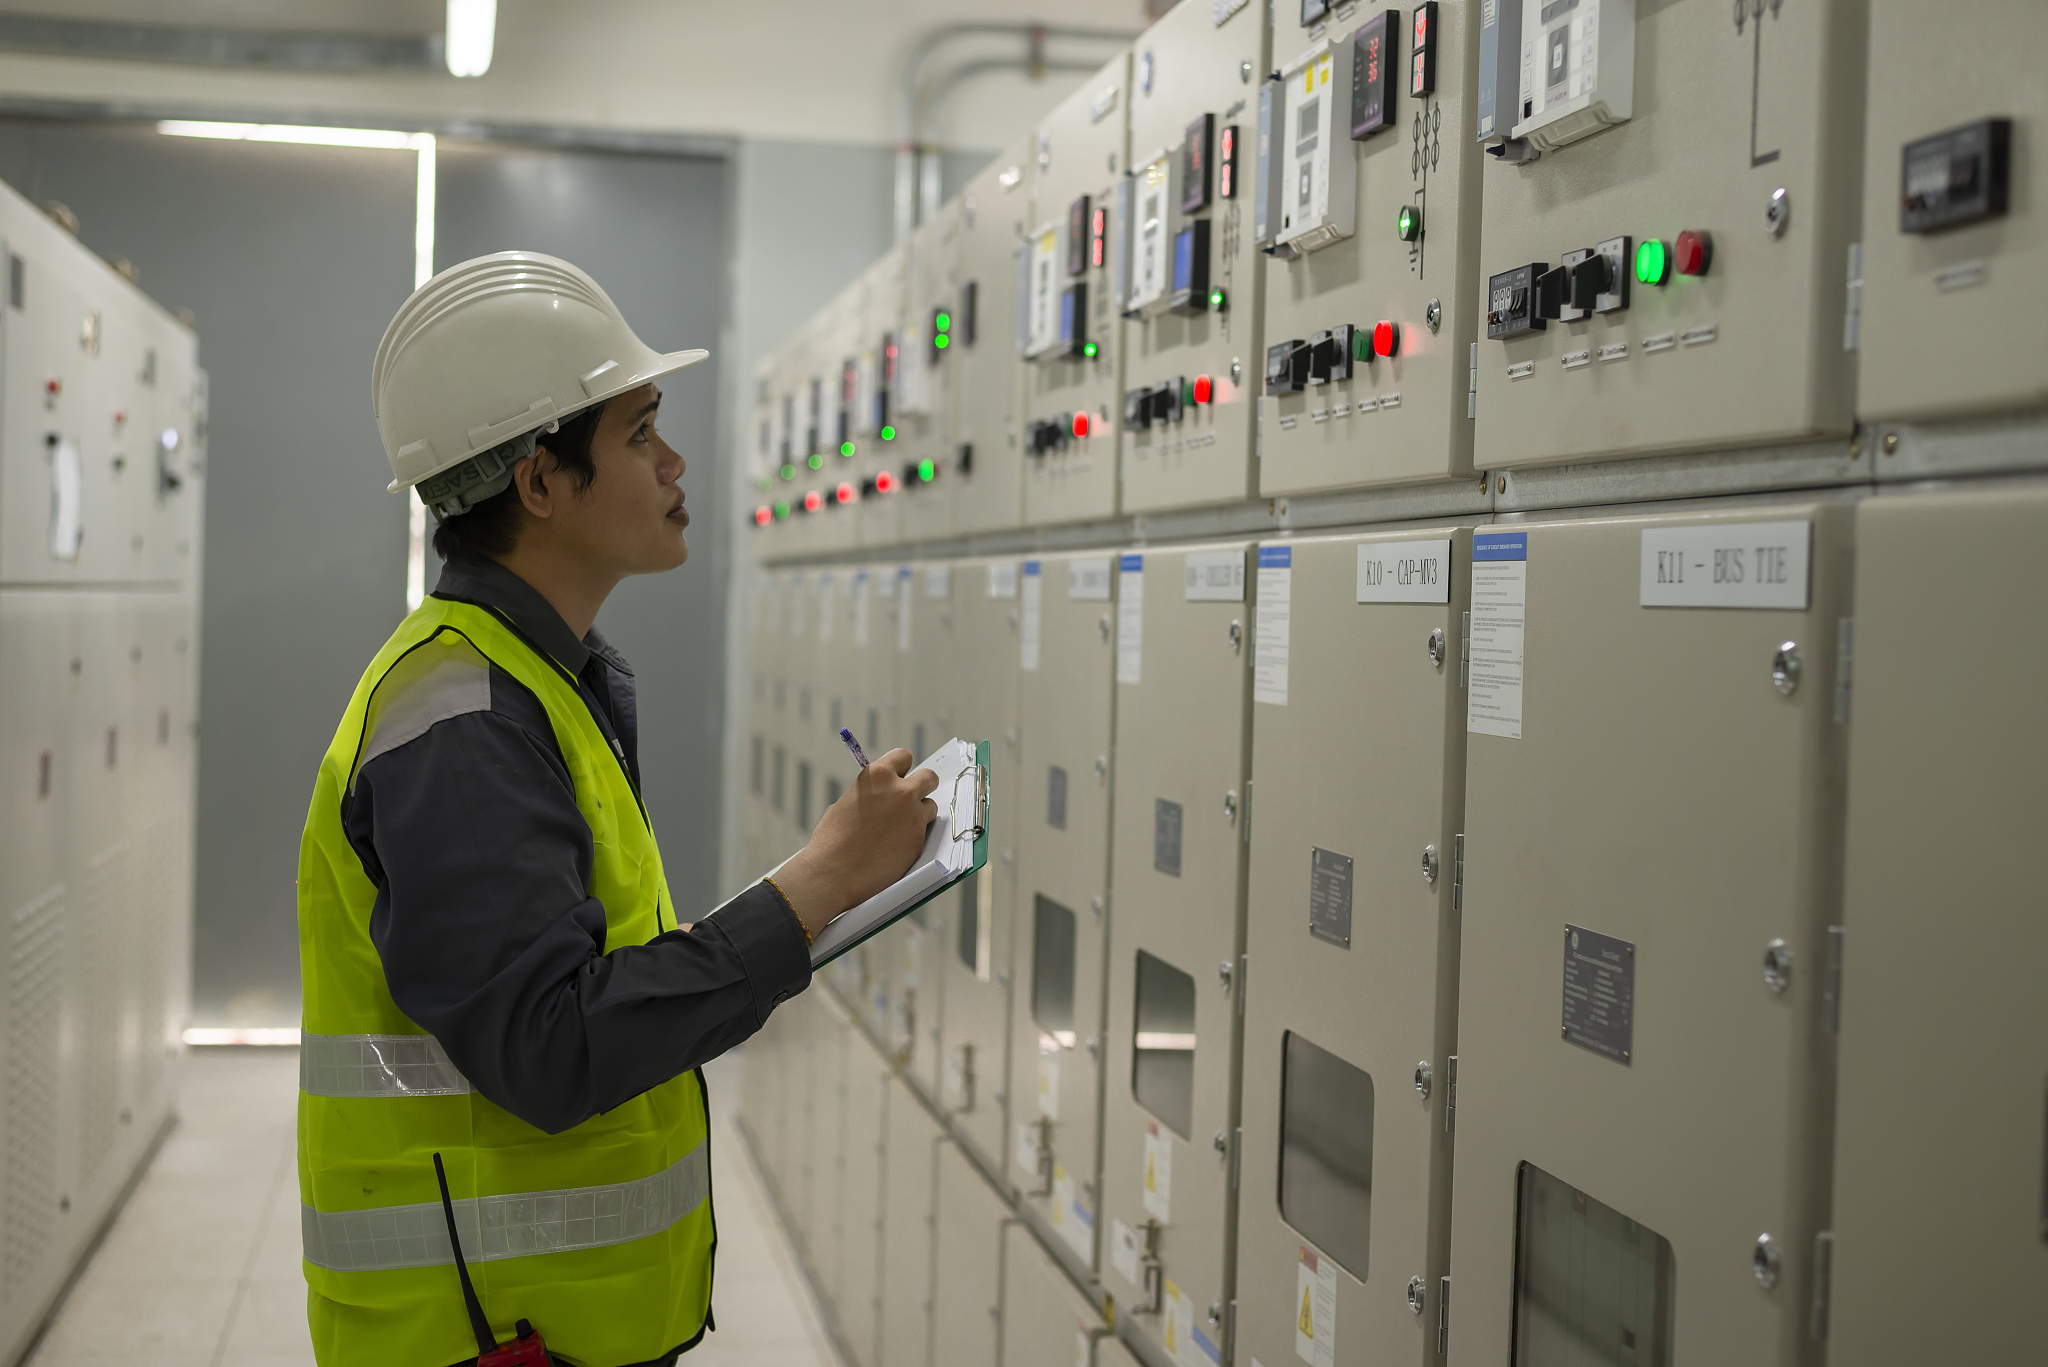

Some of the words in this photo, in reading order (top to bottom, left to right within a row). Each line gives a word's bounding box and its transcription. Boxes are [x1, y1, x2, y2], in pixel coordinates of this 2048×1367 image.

[1366, 560, 1383, 586] K10
[1397, 558, 1438, 586] CAP-MV3
[1657, 550, 1684, 584] K11
[1713, 548, 1744, 584] BUS
[1755, 546, 1787, 584] TIE
